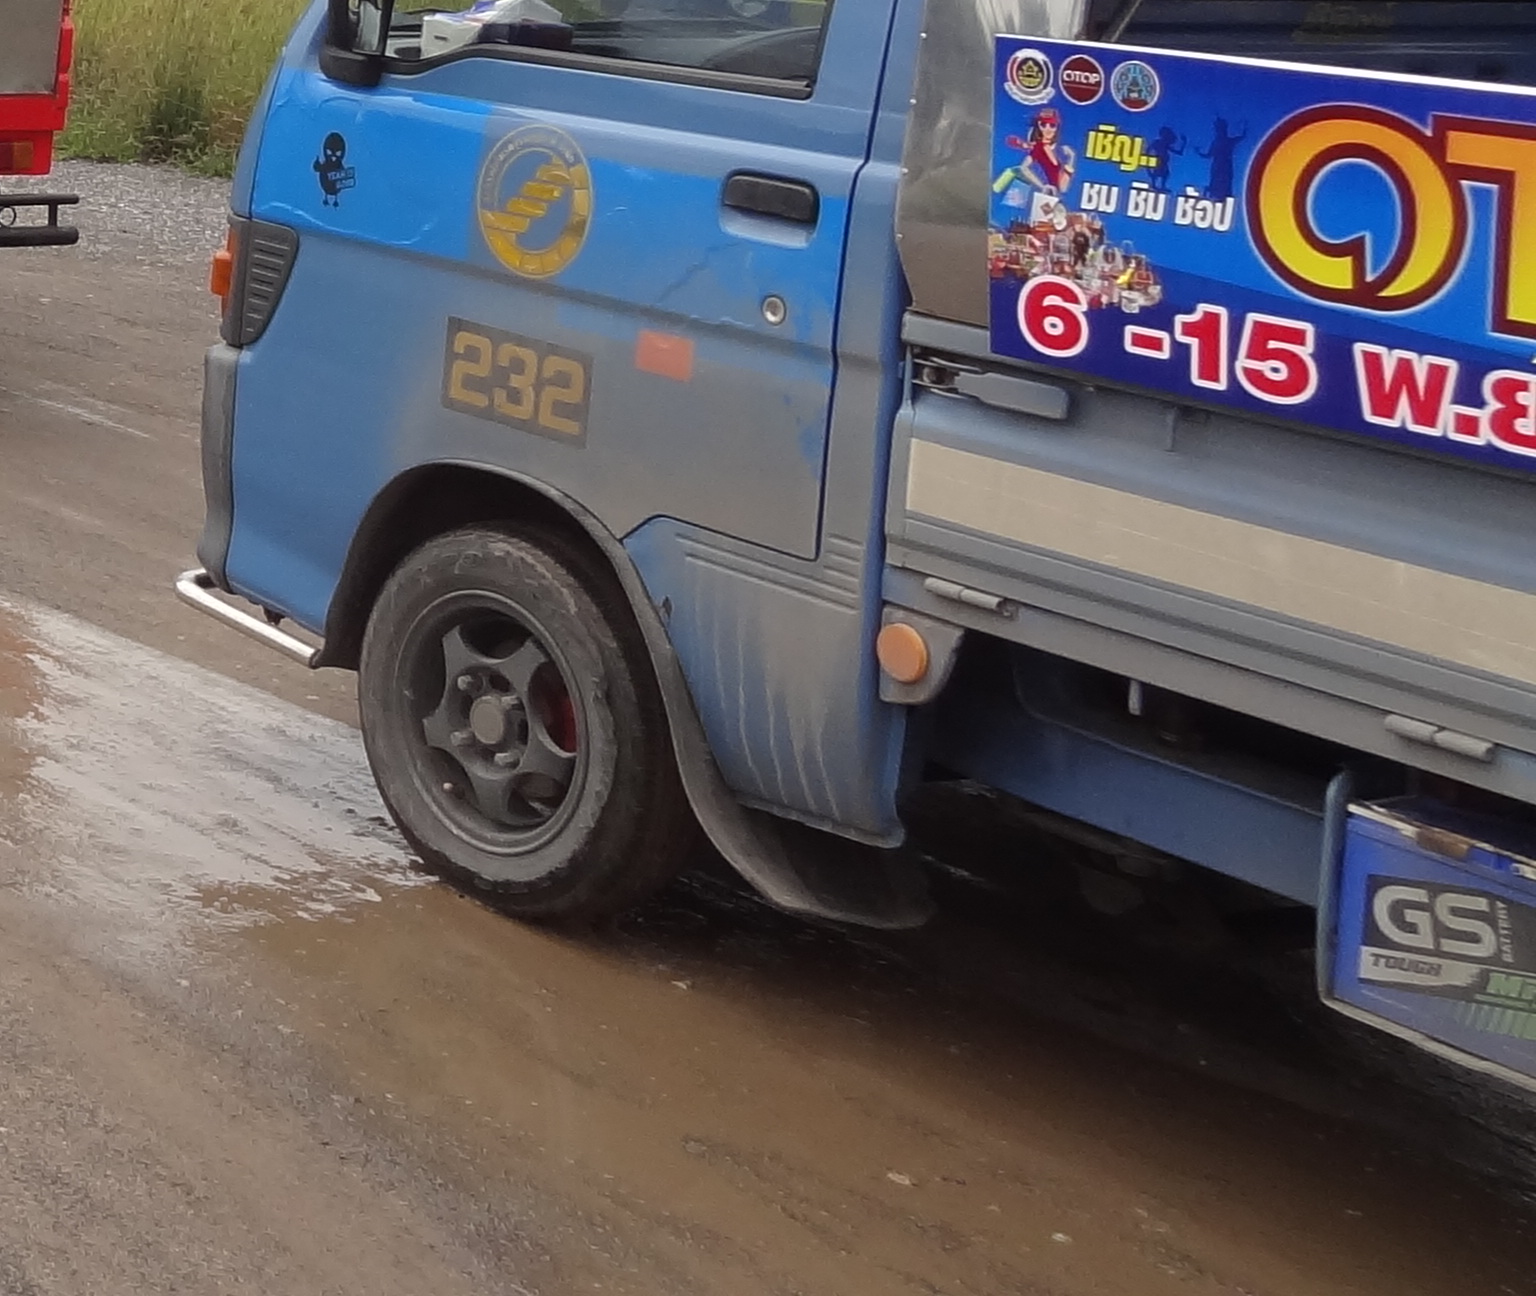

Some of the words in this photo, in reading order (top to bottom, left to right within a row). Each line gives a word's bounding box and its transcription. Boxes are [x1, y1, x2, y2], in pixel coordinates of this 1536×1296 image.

[1062, 69, 1101, 85] OTOP
[1079, 181, 1119, 213] ชม
[1127, 181, 1167, 221] ชิม
[1174, 186, 1236, 232] ช้อป
[1017, 274, 1089, 358] 6
[1125, 304, 1318, 406] -15
[448, 330, 585, 435] 232
[1373, 885, 1497, 957] GS
[1495, 900, 1515, 963] BATTERY
[1369, 952, 1442, 977] TOUGH
